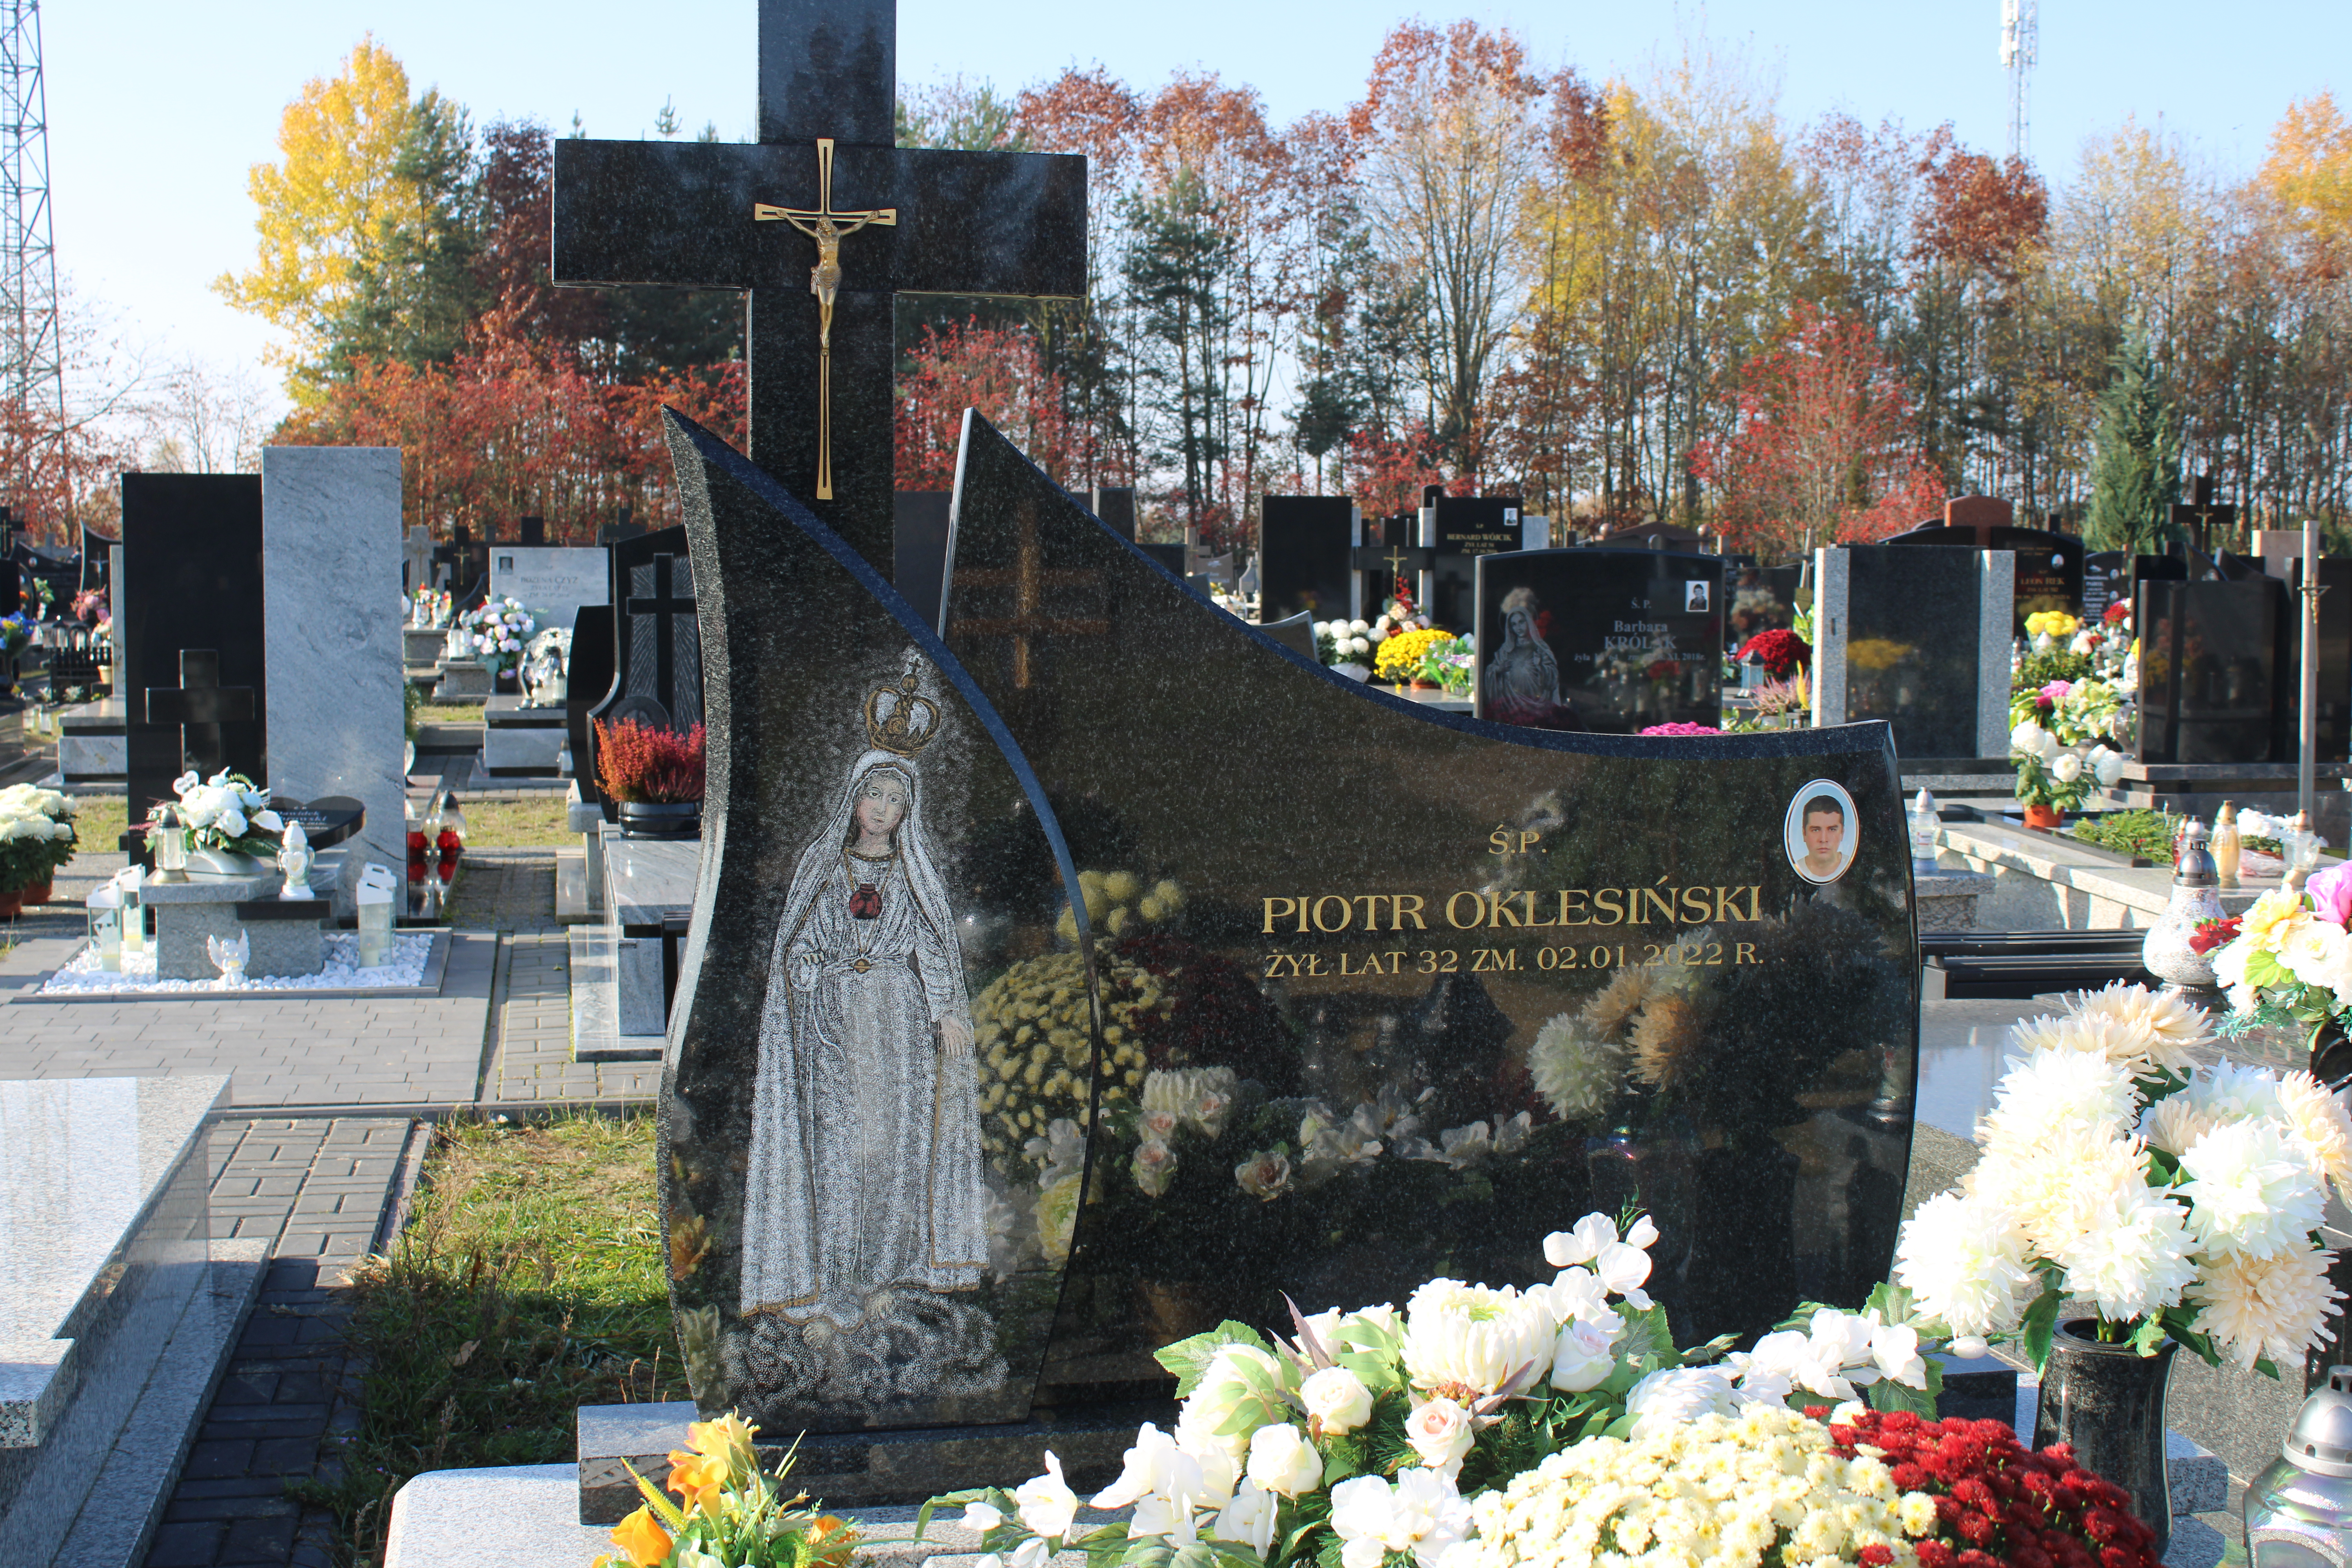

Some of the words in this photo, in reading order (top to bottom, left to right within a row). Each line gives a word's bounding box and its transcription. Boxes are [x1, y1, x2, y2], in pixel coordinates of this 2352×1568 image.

[1482, 532, 1512, 541] WÓJCIK
[1614, 620, 1668, 632] Barbara
[1604, 633, 1677, 649] KRÓLAK
[1488, 824, 1546, 855] Ś.P.
[1261, 895, 1428, 933] PIOTR
[1446, 875, 1762, 929] OKLESIŃSKI
[1265, 949, 1329, 978] ŻYŁ
[1340, 952, 1408, 975] LAT
[1417, 950, 1458, 974] 32
[1471, 948, 1524, 972] ZM.
[1537, 942, 1723, 970] 02.01.2022
[1735, 942, 1764, 964] R.
